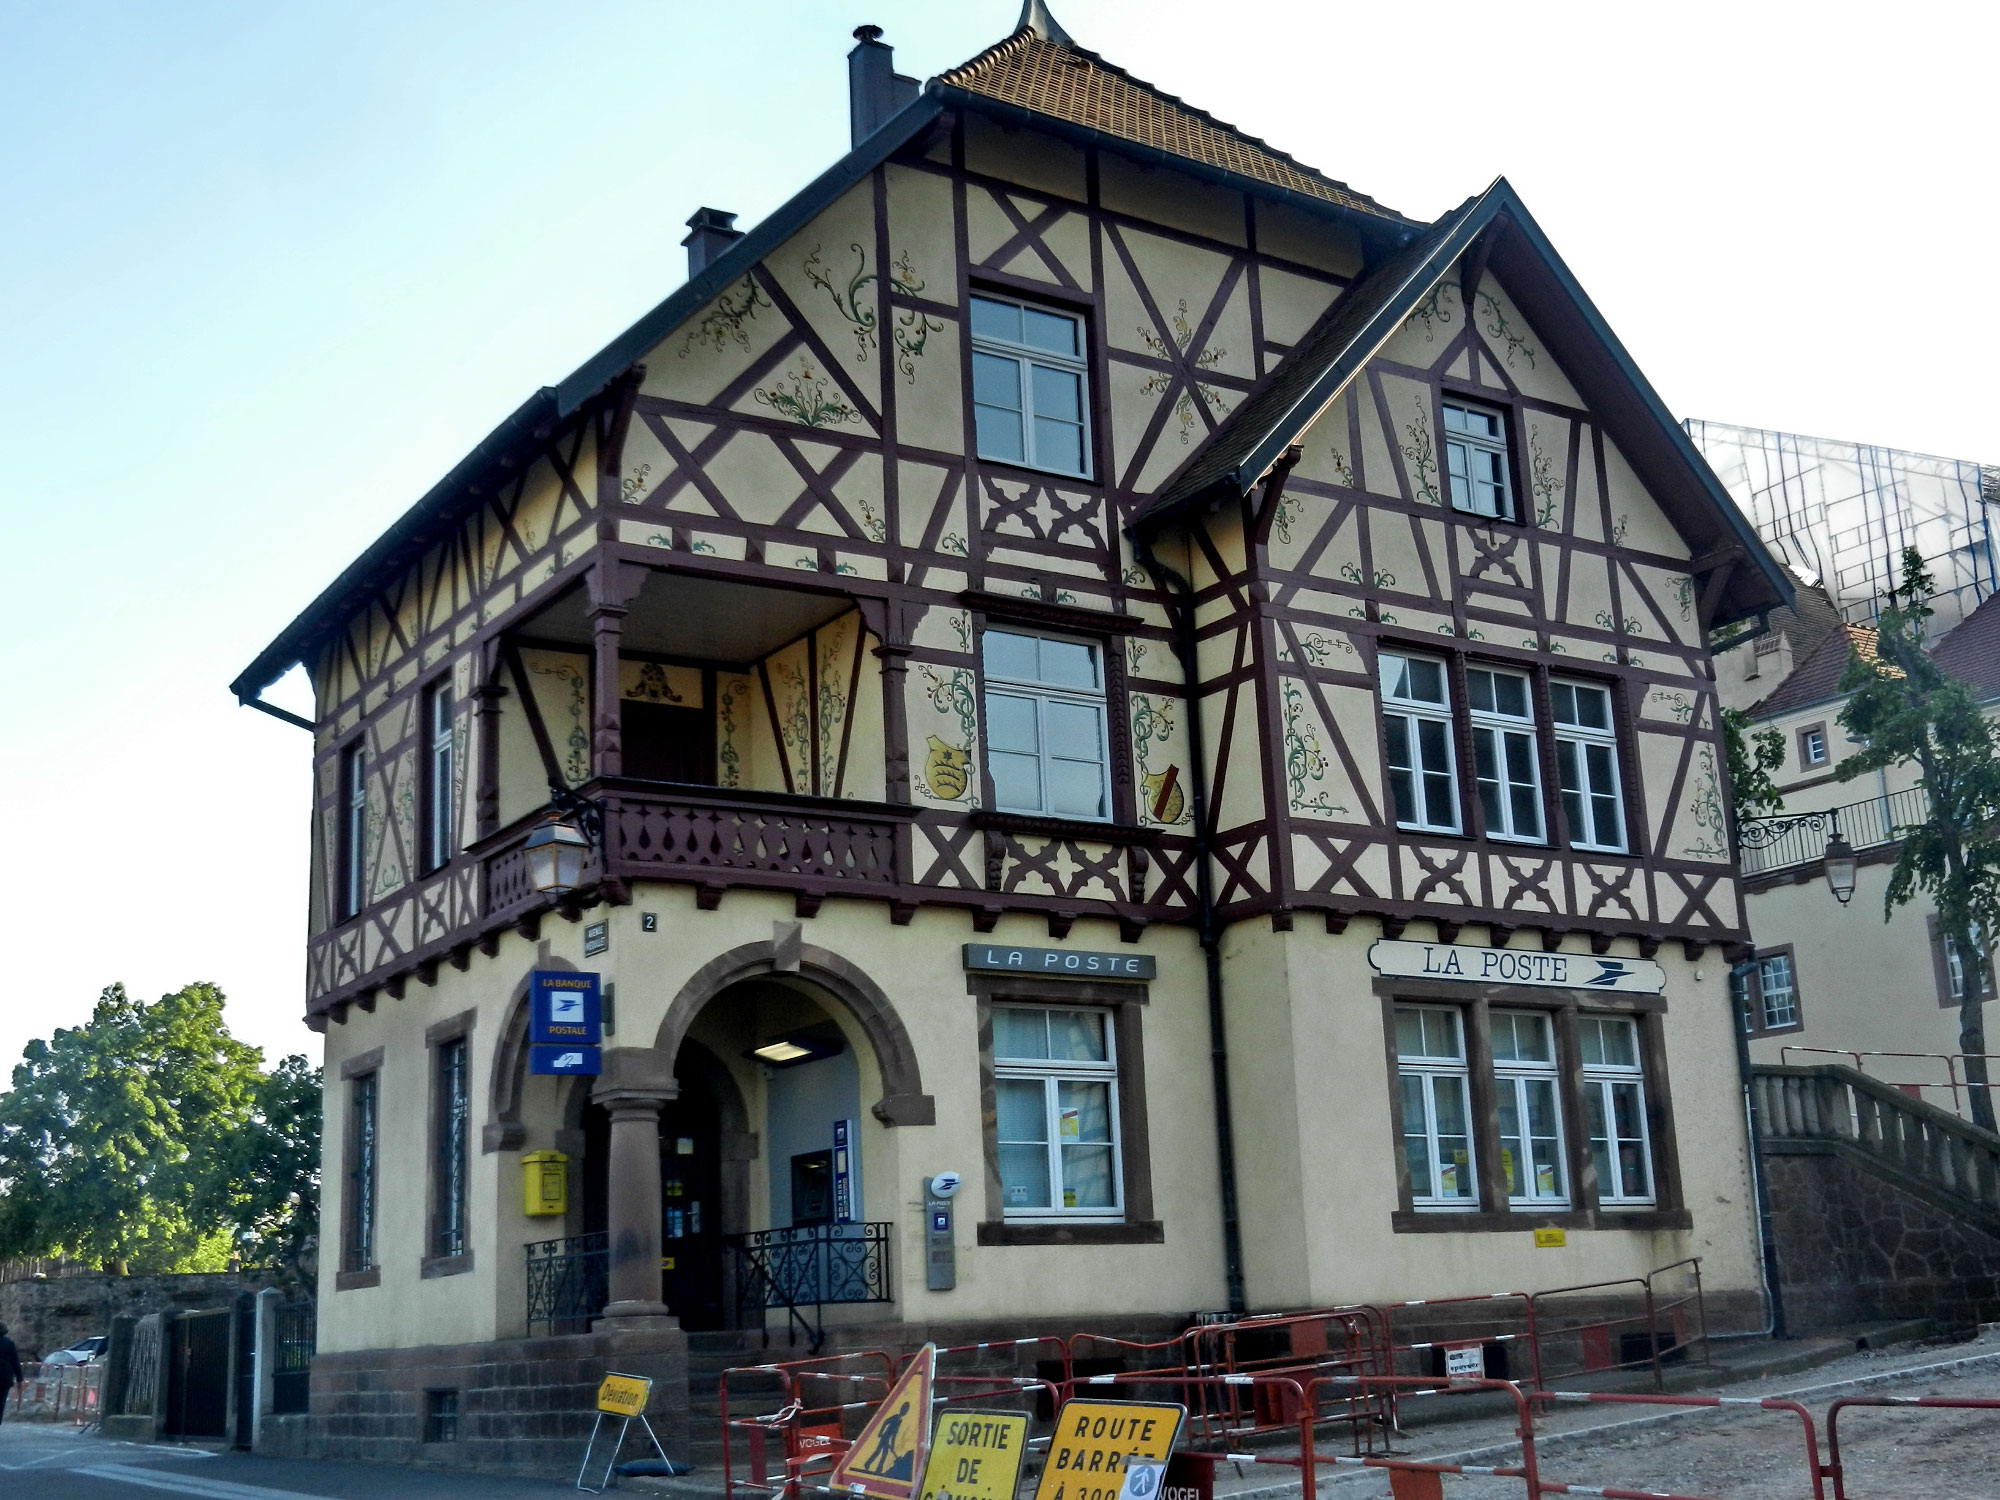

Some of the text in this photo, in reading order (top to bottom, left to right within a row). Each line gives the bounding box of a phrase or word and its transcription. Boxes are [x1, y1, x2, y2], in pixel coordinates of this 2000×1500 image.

[646, 916, 654, 929] 2
[986, 949, 1140, 973] LA POSTE
[1422, 947, 1568, 983] LA POSTE
[543, 979, 592, 988] LA BANQUE
[549, 1025, 587, 1035] POSTALE
[601, 1383, 639, 1407] Déviation
[946, 1421, 1011, 1450] SORTIE
[1074, 1416, 1157, 1442] ROUTE
[956, 1457, 982, 1485] DE
[1056, 1446, 1156, 1475] BARRÉ
